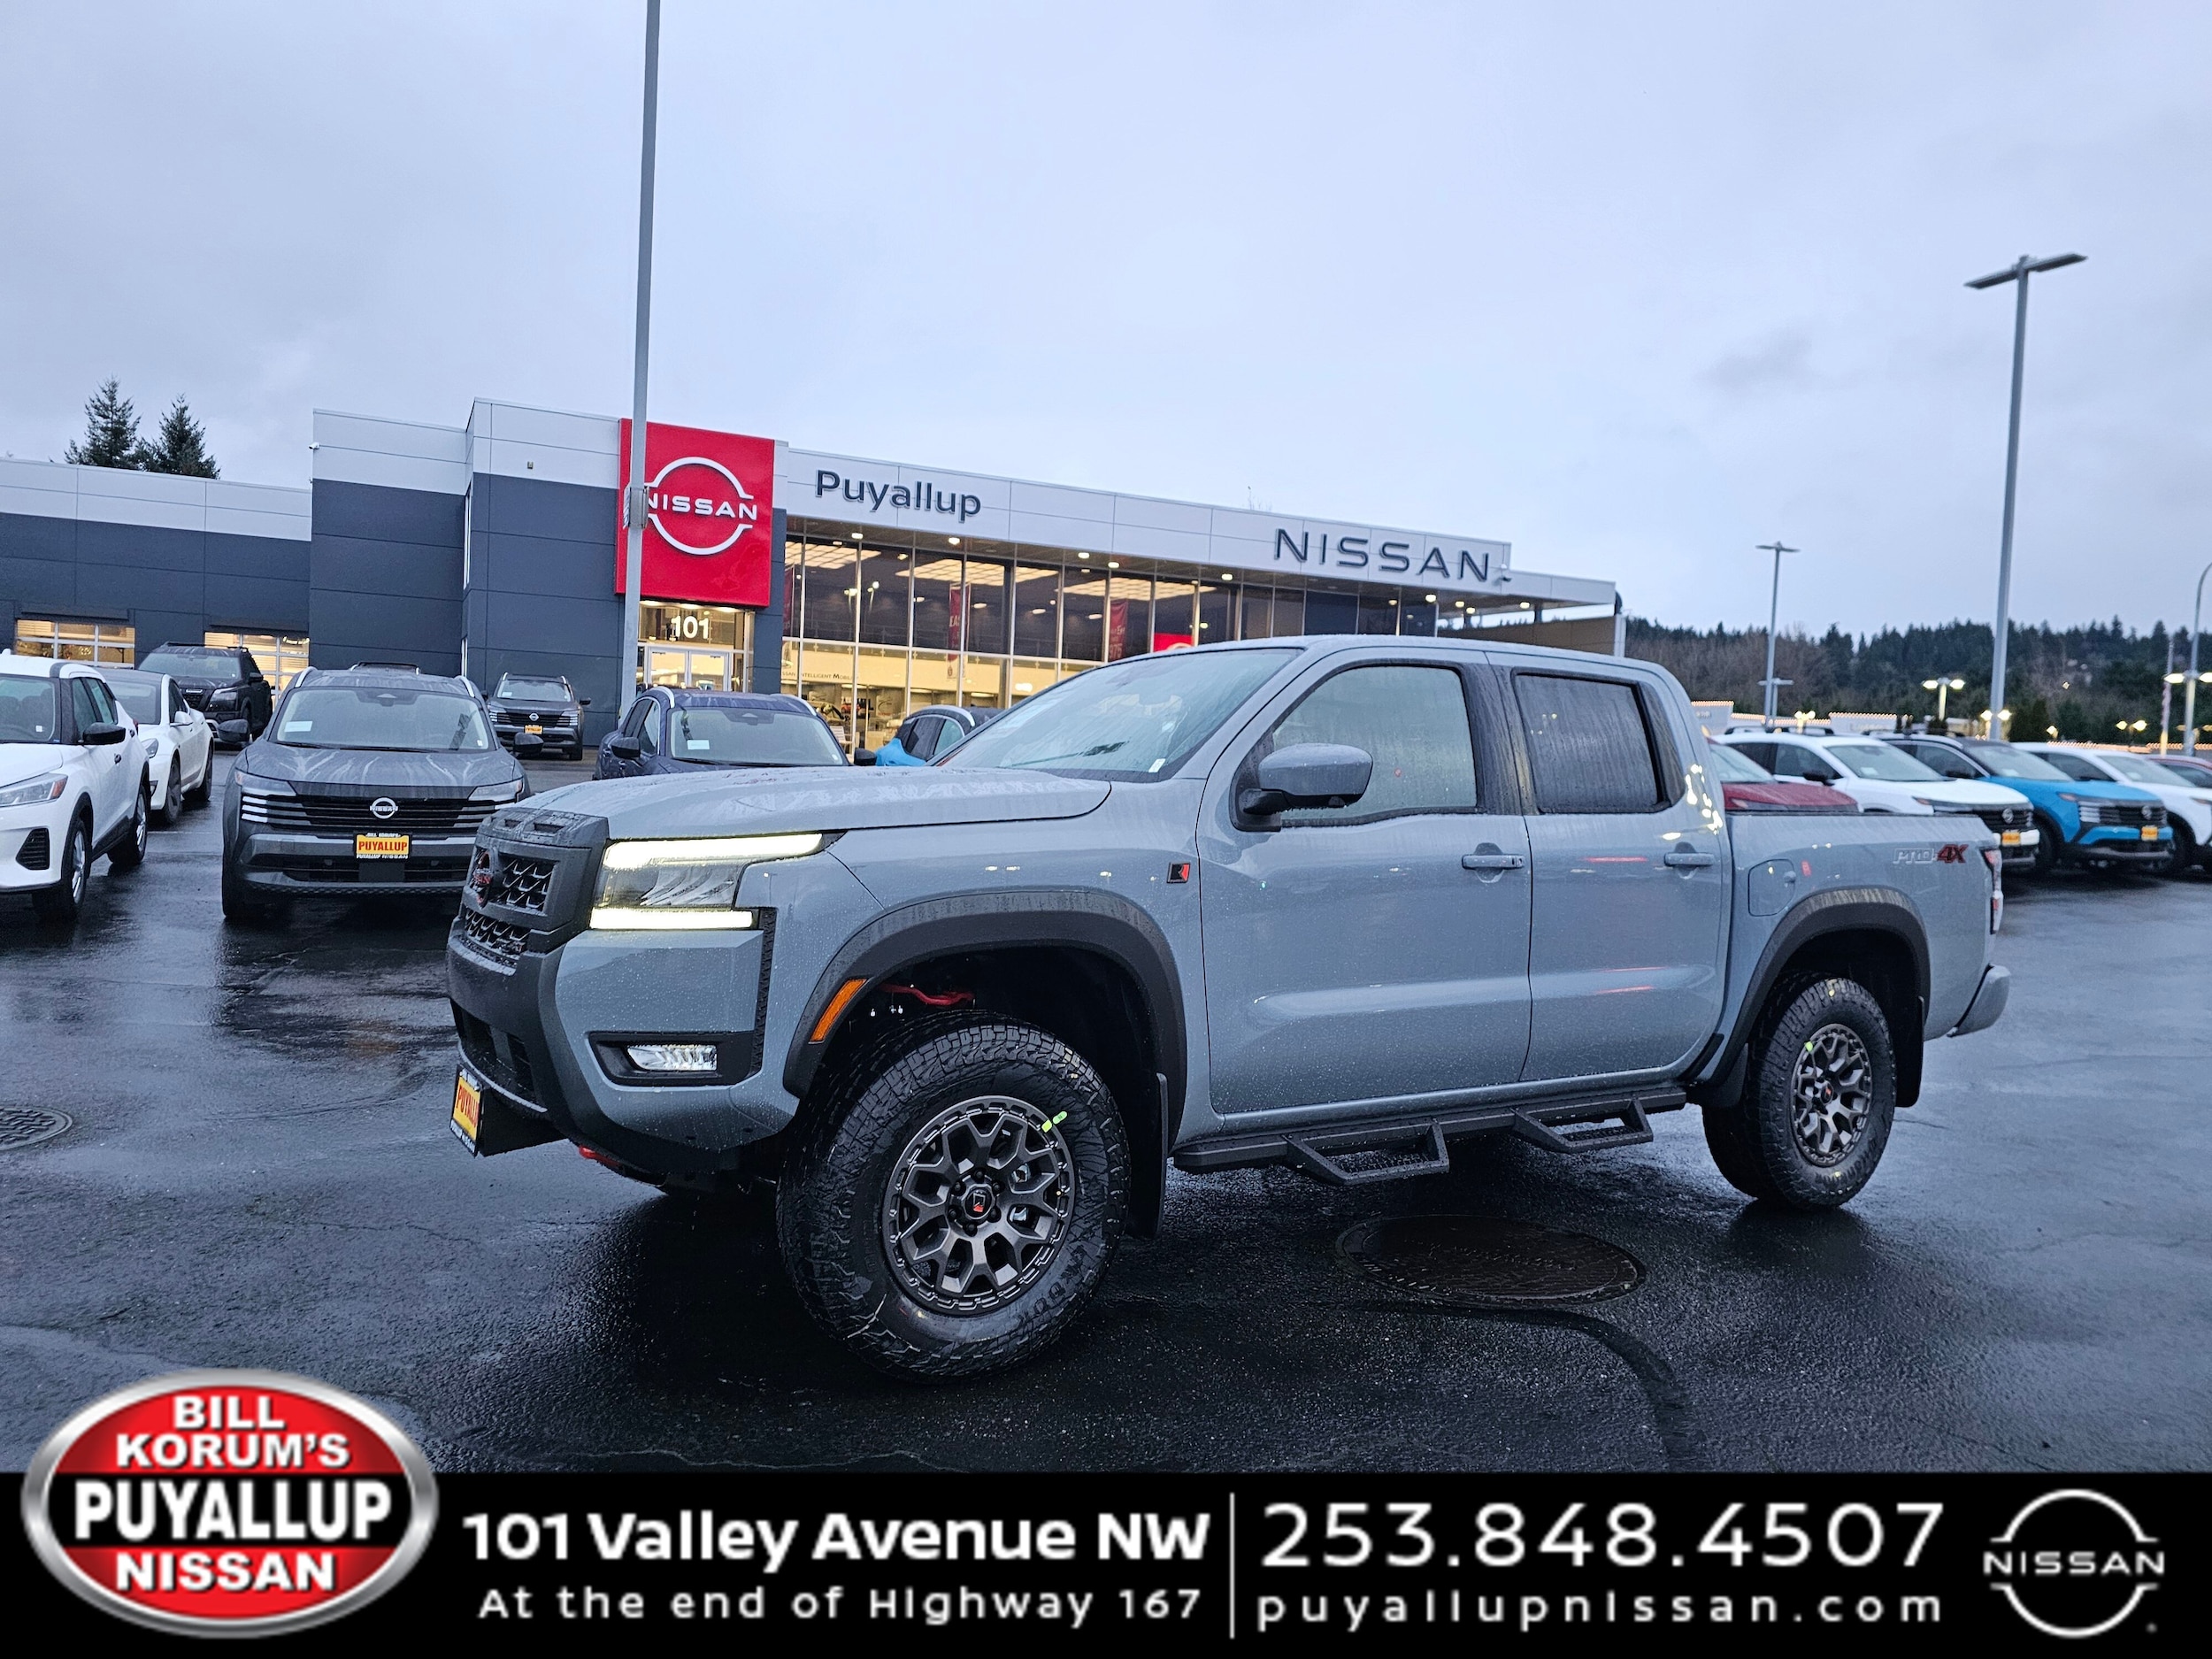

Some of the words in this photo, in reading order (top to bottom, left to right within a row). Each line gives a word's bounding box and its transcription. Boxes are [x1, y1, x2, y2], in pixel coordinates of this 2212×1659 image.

[816, 470, 981, 523] Puyallup
[1274, 528, 1489, 581] NISSAN
[671, 615, 709, 640] 101
[358, 841, 408, 851] PUYALLUP
